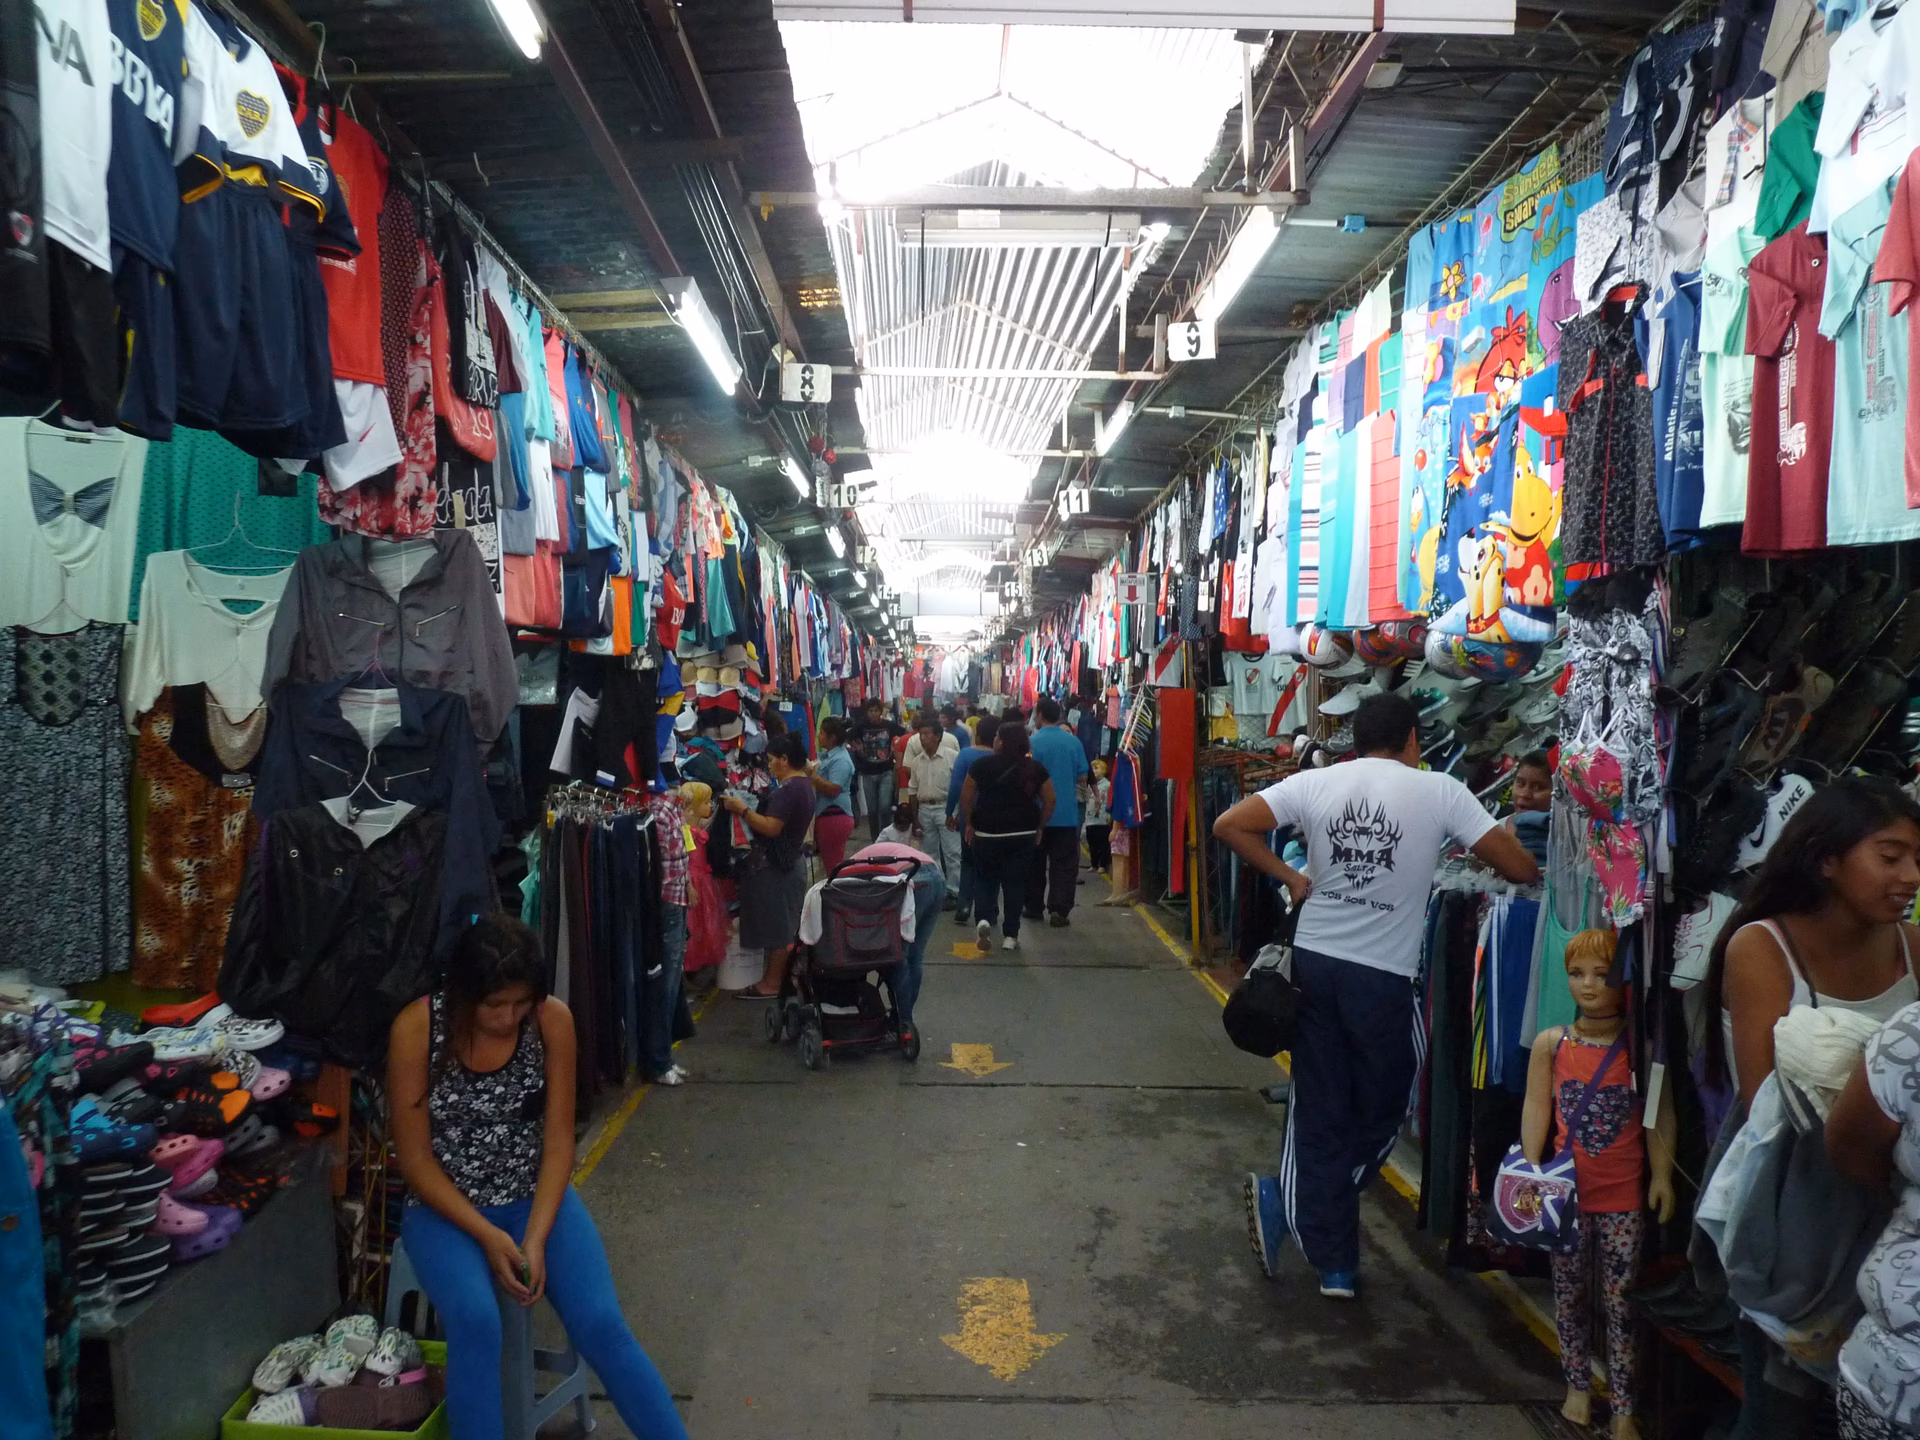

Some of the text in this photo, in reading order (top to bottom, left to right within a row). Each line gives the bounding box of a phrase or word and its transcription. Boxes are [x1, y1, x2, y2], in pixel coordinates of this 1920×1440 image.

[110, 31, 175, 149] BBVA
[1187, 322, 1201, 358] 9
[800, 364, 815, 402] 8
[833, 484, 858, 507] 10
[1063, 491, 1084, 514] 11
[860, 547, 877, 563] 12
[1028, 550, 1045, 566] 13
[878, 586, 893, 600] 14
[1007, 583, 1020, 596] 15
[1778, 784, 1806, 821] NIKE
[1329, 841, 1396, 873] MMA
[1370, 900, 1396, 912] VOS
